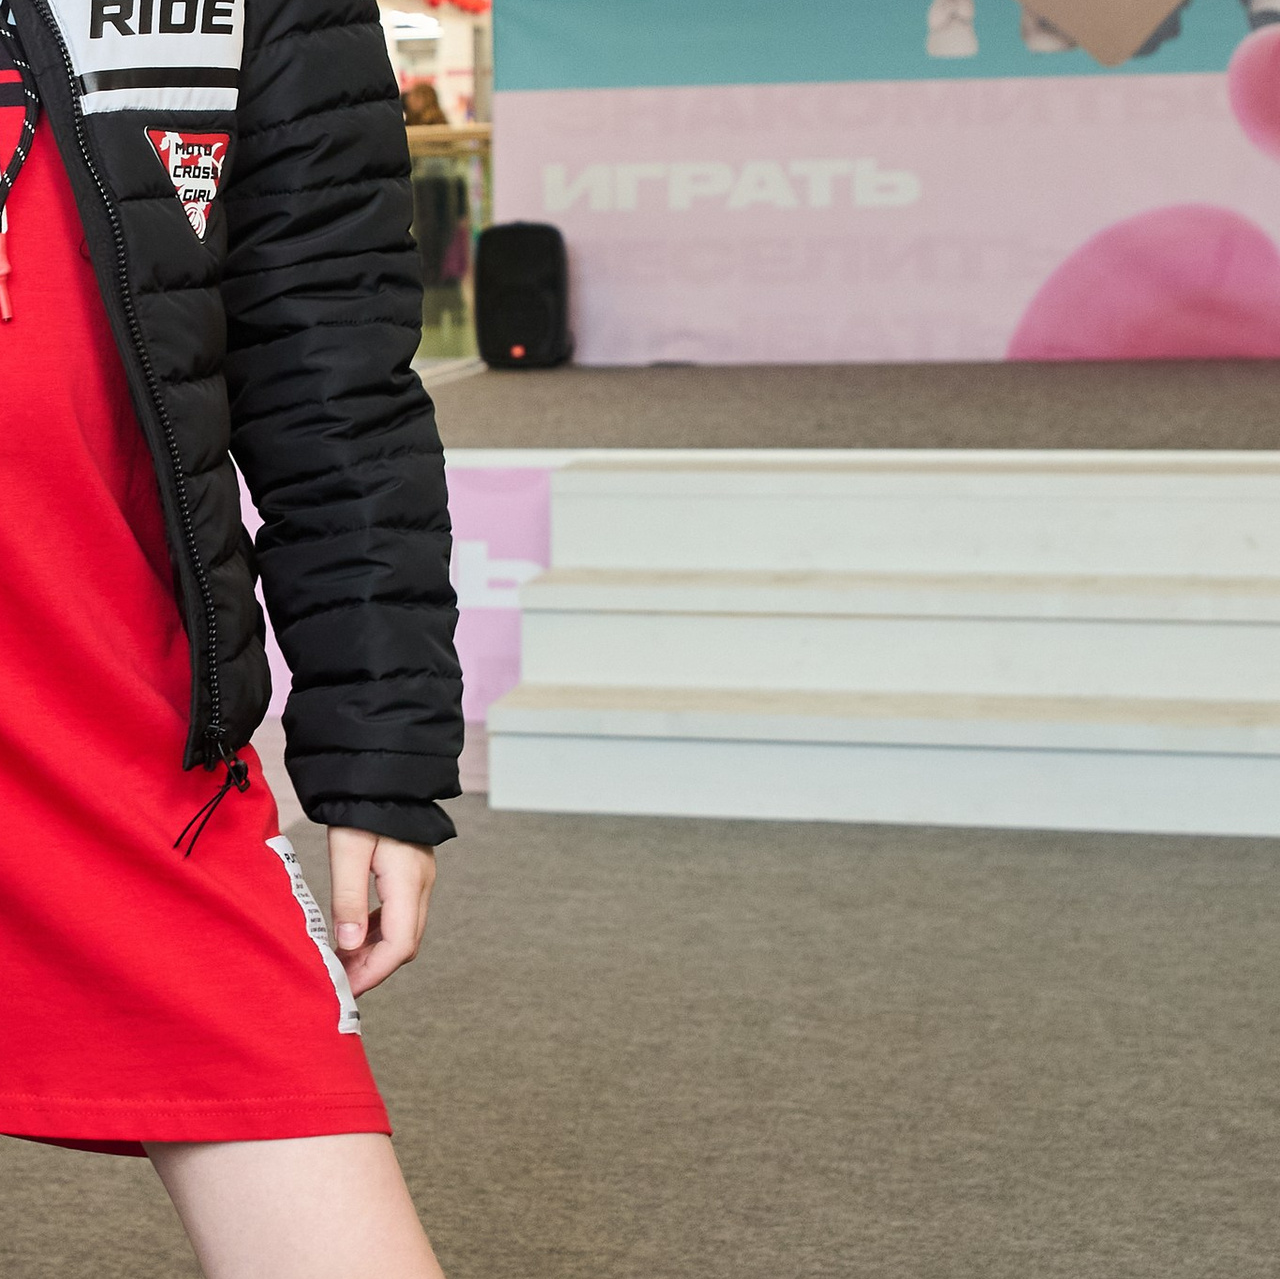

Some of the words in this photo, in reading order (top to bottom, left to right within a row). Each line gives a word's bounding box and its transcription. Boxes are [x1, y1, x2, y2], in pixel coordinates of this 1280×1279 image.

[175, 143, 213, 156] MOTO
[172, 165, 218, 180] CROSS
[542, 158, 921, 213] ИГРАТЬ
[182, 189, 214, 202] GIRL
